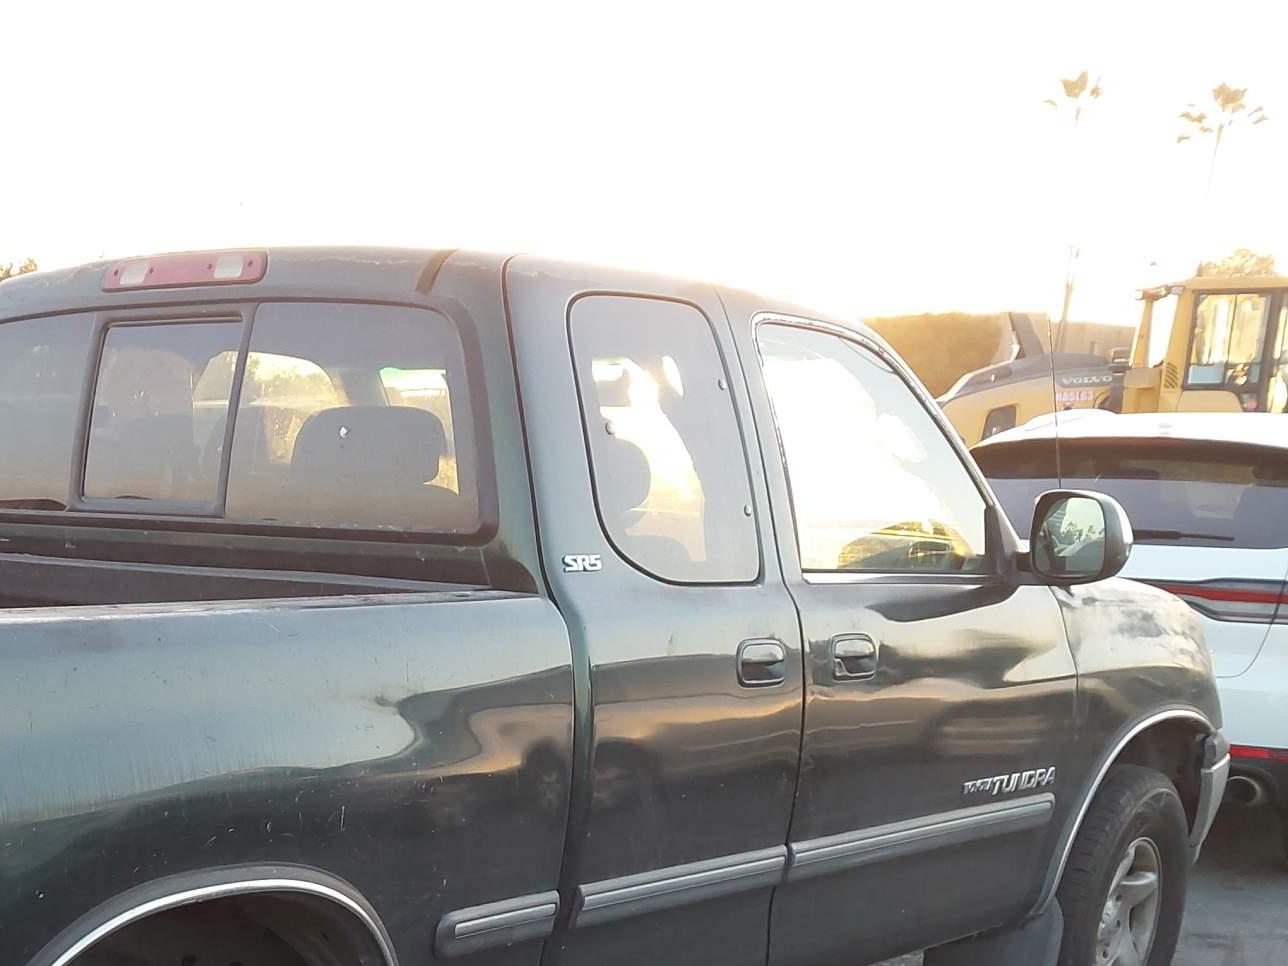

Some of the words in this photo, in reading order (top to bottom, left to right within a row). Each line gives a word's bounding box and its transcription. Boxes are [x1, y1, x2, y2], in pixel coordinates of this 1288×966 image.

[1062, 375, 1113, 385] VOLVO
[562, 554, 602, 573] SR5
[992, 766, 1056, 796] TUNDRA
